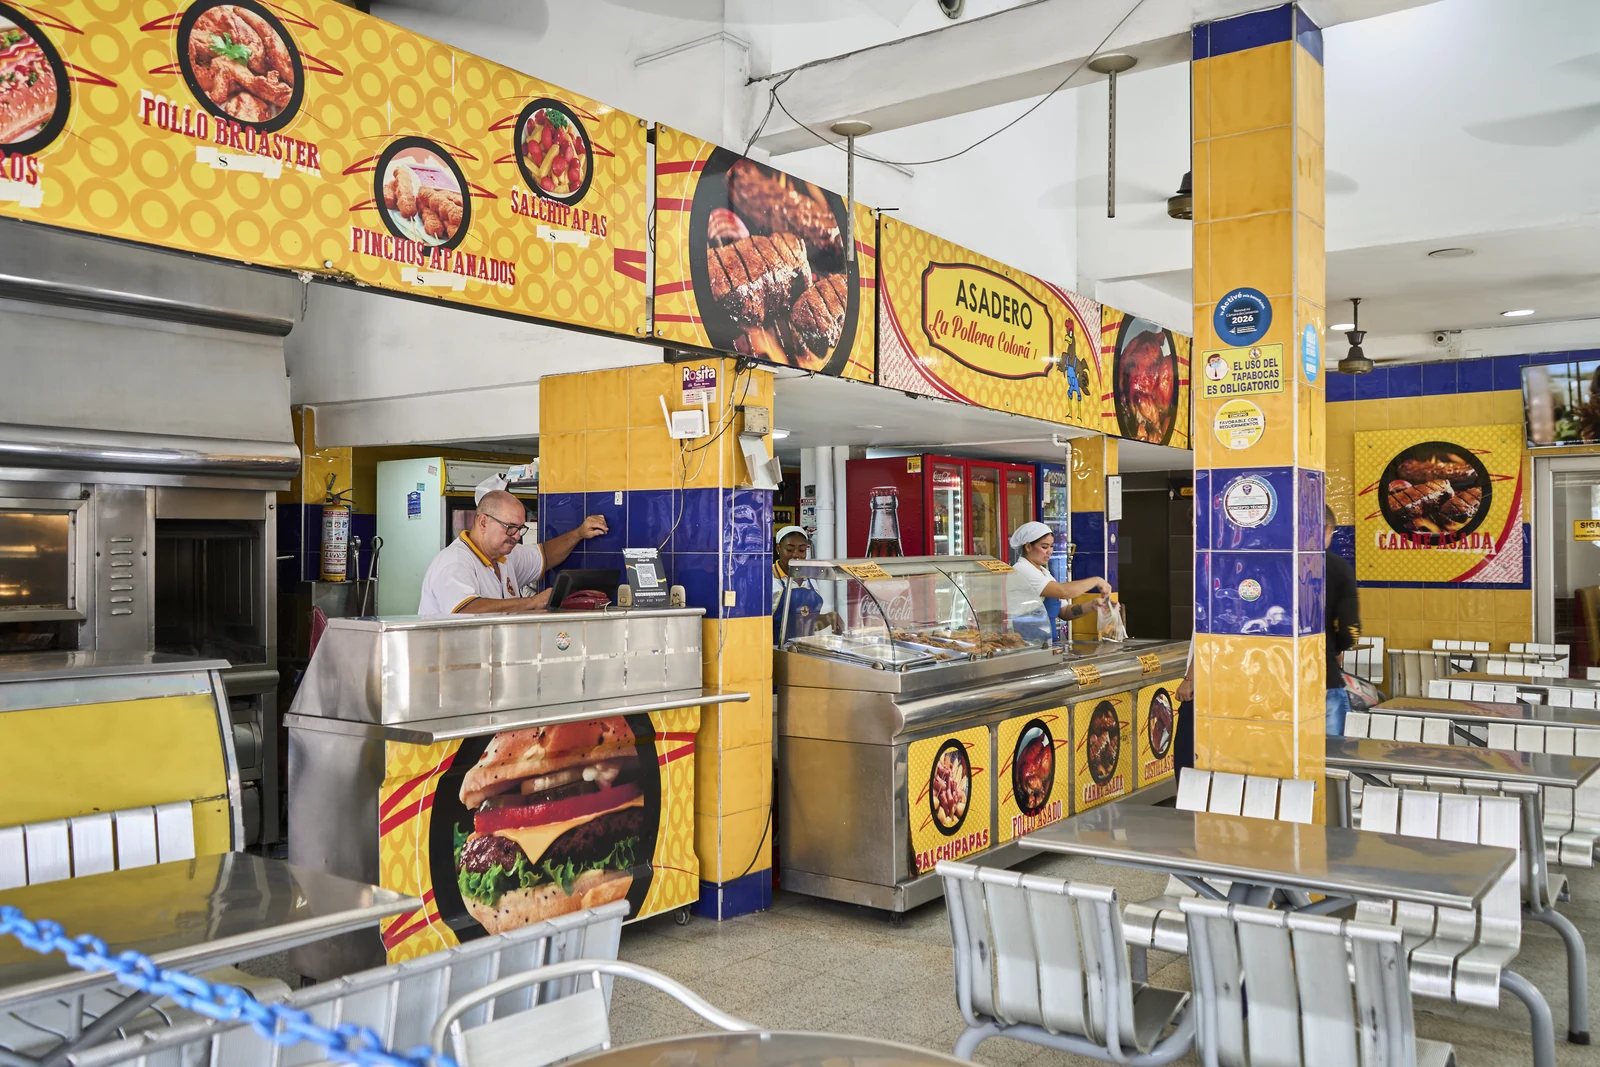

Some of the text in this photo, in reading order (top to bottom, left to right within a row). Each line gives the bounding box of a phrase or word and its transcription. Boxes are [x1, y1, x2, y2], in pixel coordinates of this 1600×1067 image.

[143, 97, 321, 170] POLLO BROASTER
[511, 189, 608, 238] SALCHIPAPAS
[351, 227, 516, 286] PINCHOS APANADOS
[955, 279, 1033, 330] ASADERO
[1231, 315, 1254, 324] 2026
[929, 309, 948, 340] La
[951, 315, 995, 350] Pollera
[998, 332, 1031, 360] Colorá
[683, 365, 716, 382] Rosita
[1232, 369, 1280, 382] TAPABOCAS
[1233, 358, 1279, 371] EL USO DEL
[1207, 379, 1280, 395] ES OBLIGATORIO
[1219, 421, 1259, 430] REQUERIMIENTOS
[1580, 521, 1600, 529] SIGA
[1378, 532, 1494, 550] CARNE ASADA
[858, 594, 913, 621] Coca-Cola
[1105, 774, 1124, 796] ASADA
[1012, 799, 1062, 841] POLLO ASADO
[915, 828, 989, 872] SALCHIPAPAS
